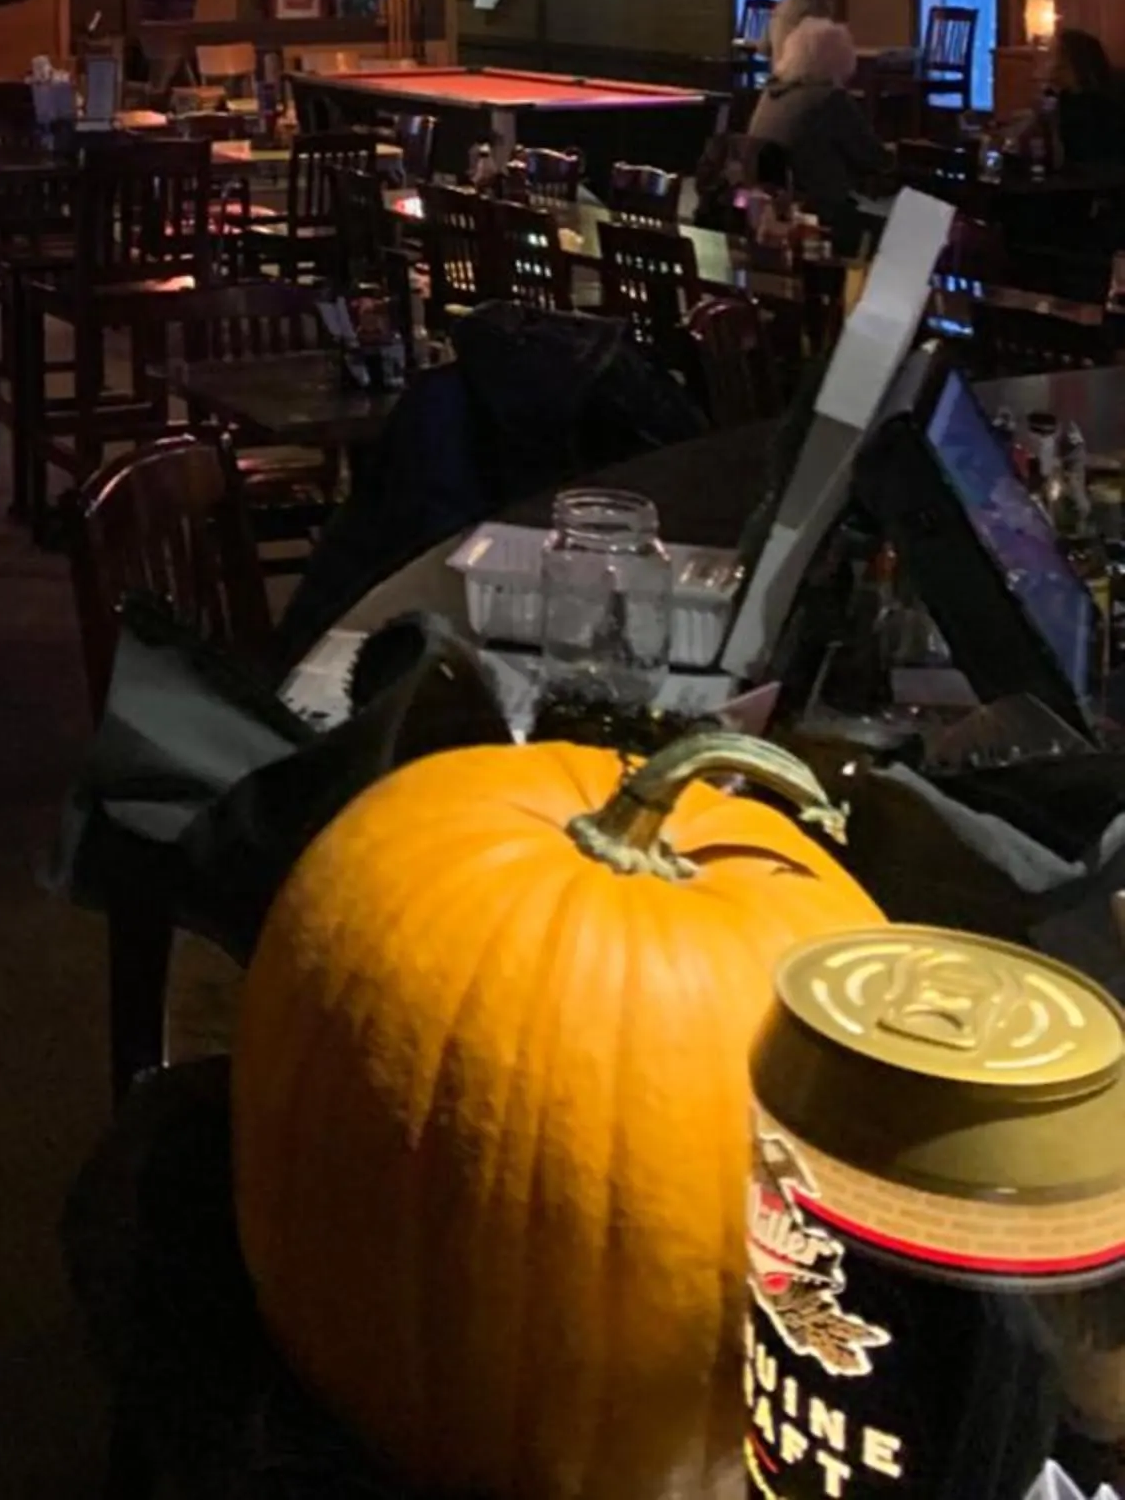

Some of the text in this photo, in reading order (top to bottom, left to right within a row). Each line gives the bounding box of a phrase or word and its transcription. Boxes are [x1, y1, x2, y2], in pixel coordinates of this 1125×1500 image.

[748, 1186, 832, 1266] iller
[745, 1316, 902, 1479] UINE
[745, 1362, 851, 1499] AFT
